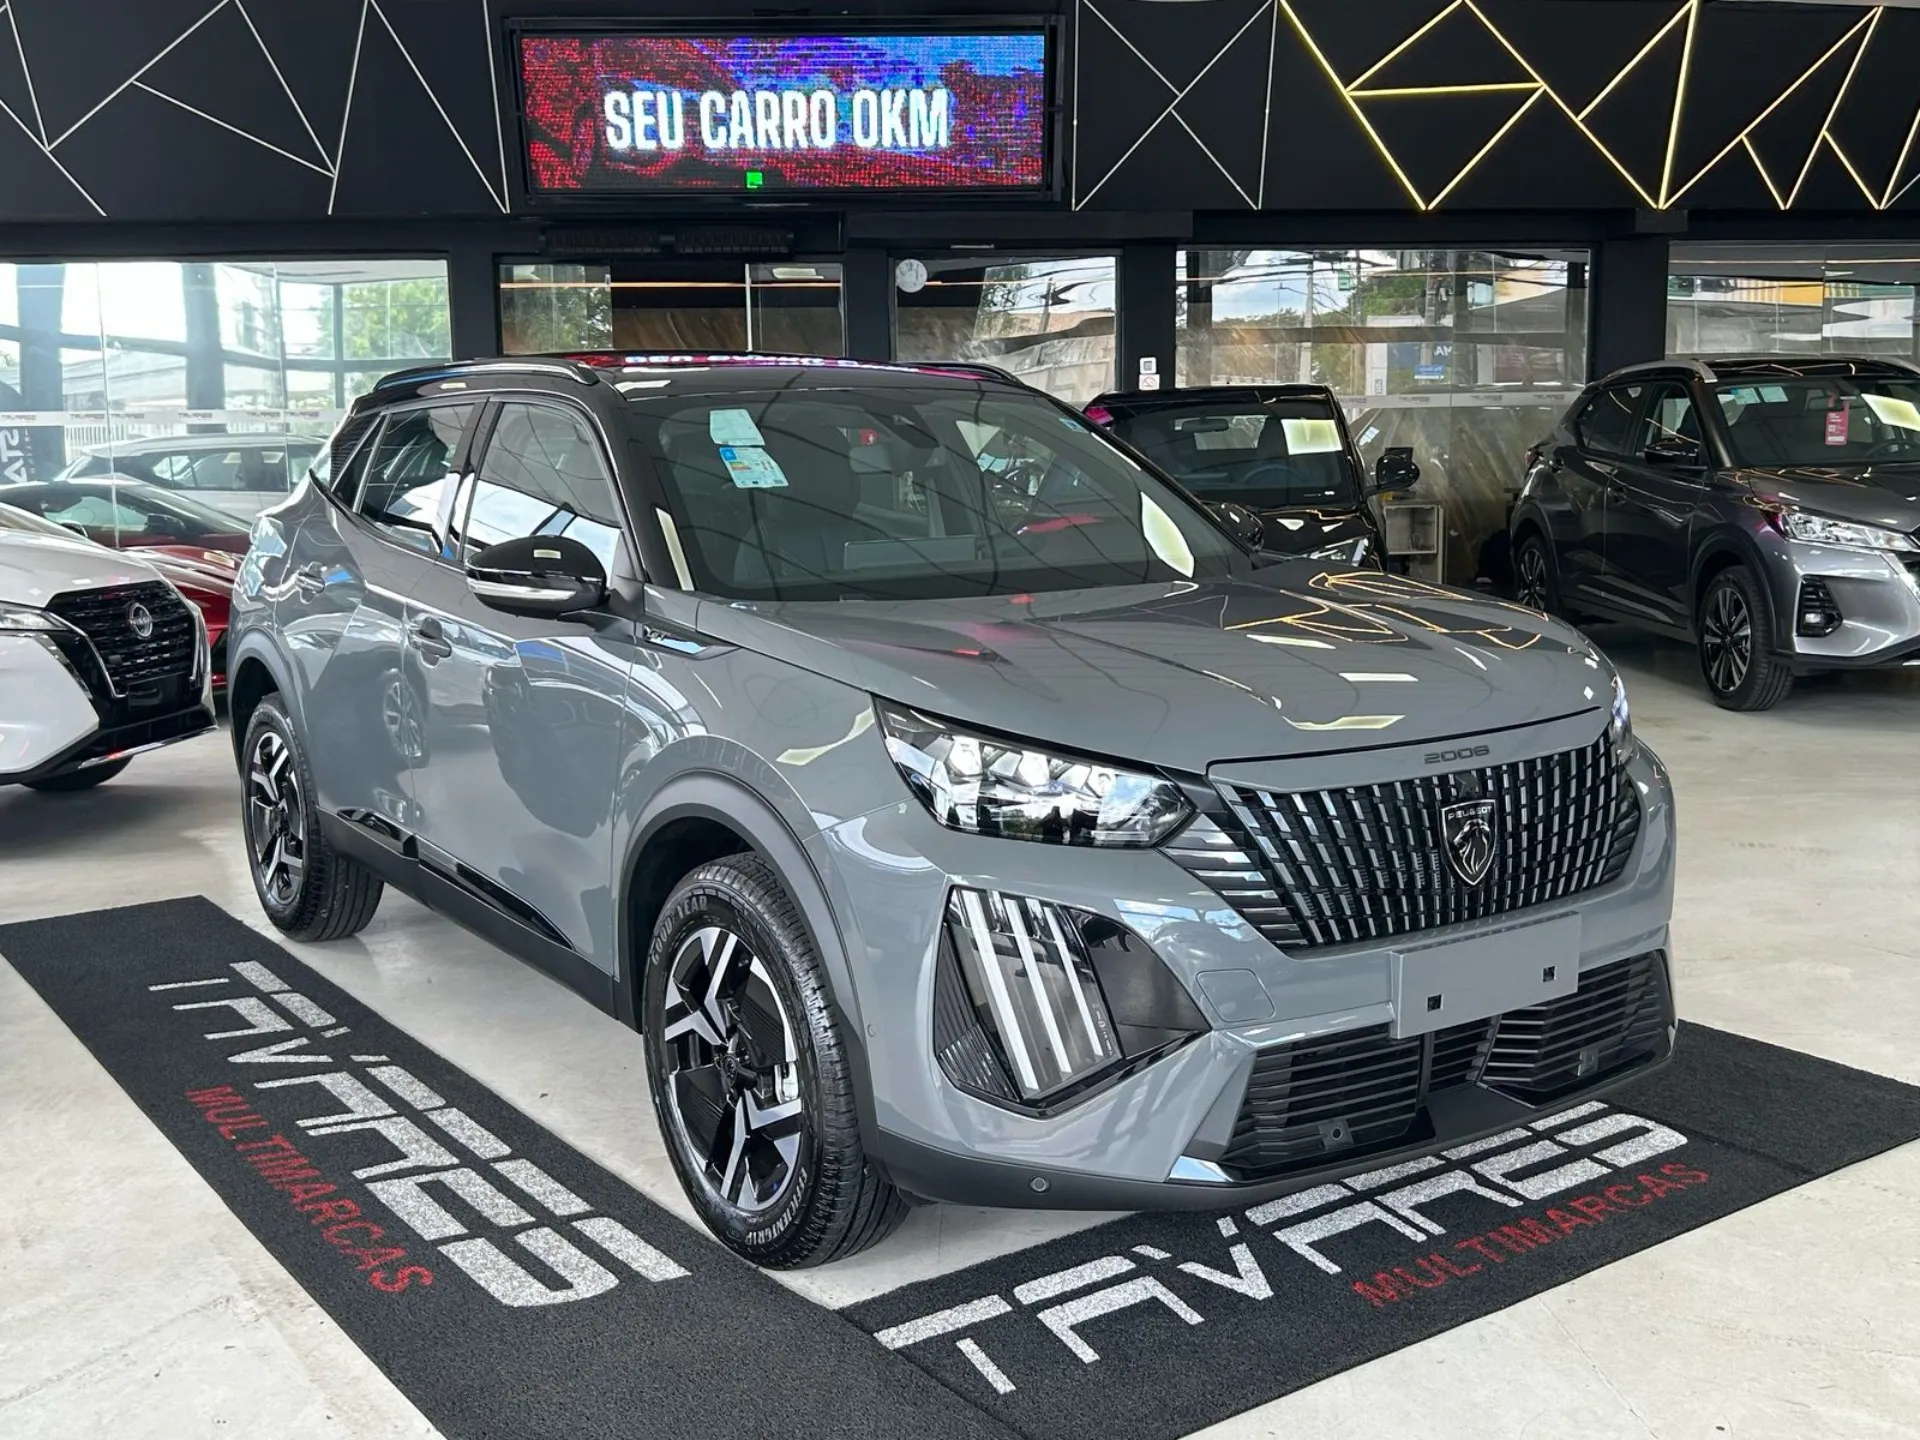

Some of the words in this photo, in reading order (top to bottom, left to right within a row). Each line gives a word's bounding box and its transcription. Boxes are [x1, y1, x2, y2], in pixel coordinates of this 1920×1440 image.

[604, 90, 685, 149] SEU
[700, 89, 836, 149] CARRO
[1447, 805, 1492, 820] PEUGEOT
[149, 960, 692, 1306] TAVARES
[185, 1084, 435, 1293] MULTIMARCAS
[874, 1100, 1688, 1394] TAVARES
[1352, 1162, 1710, 1308] MULTIMARCAS
